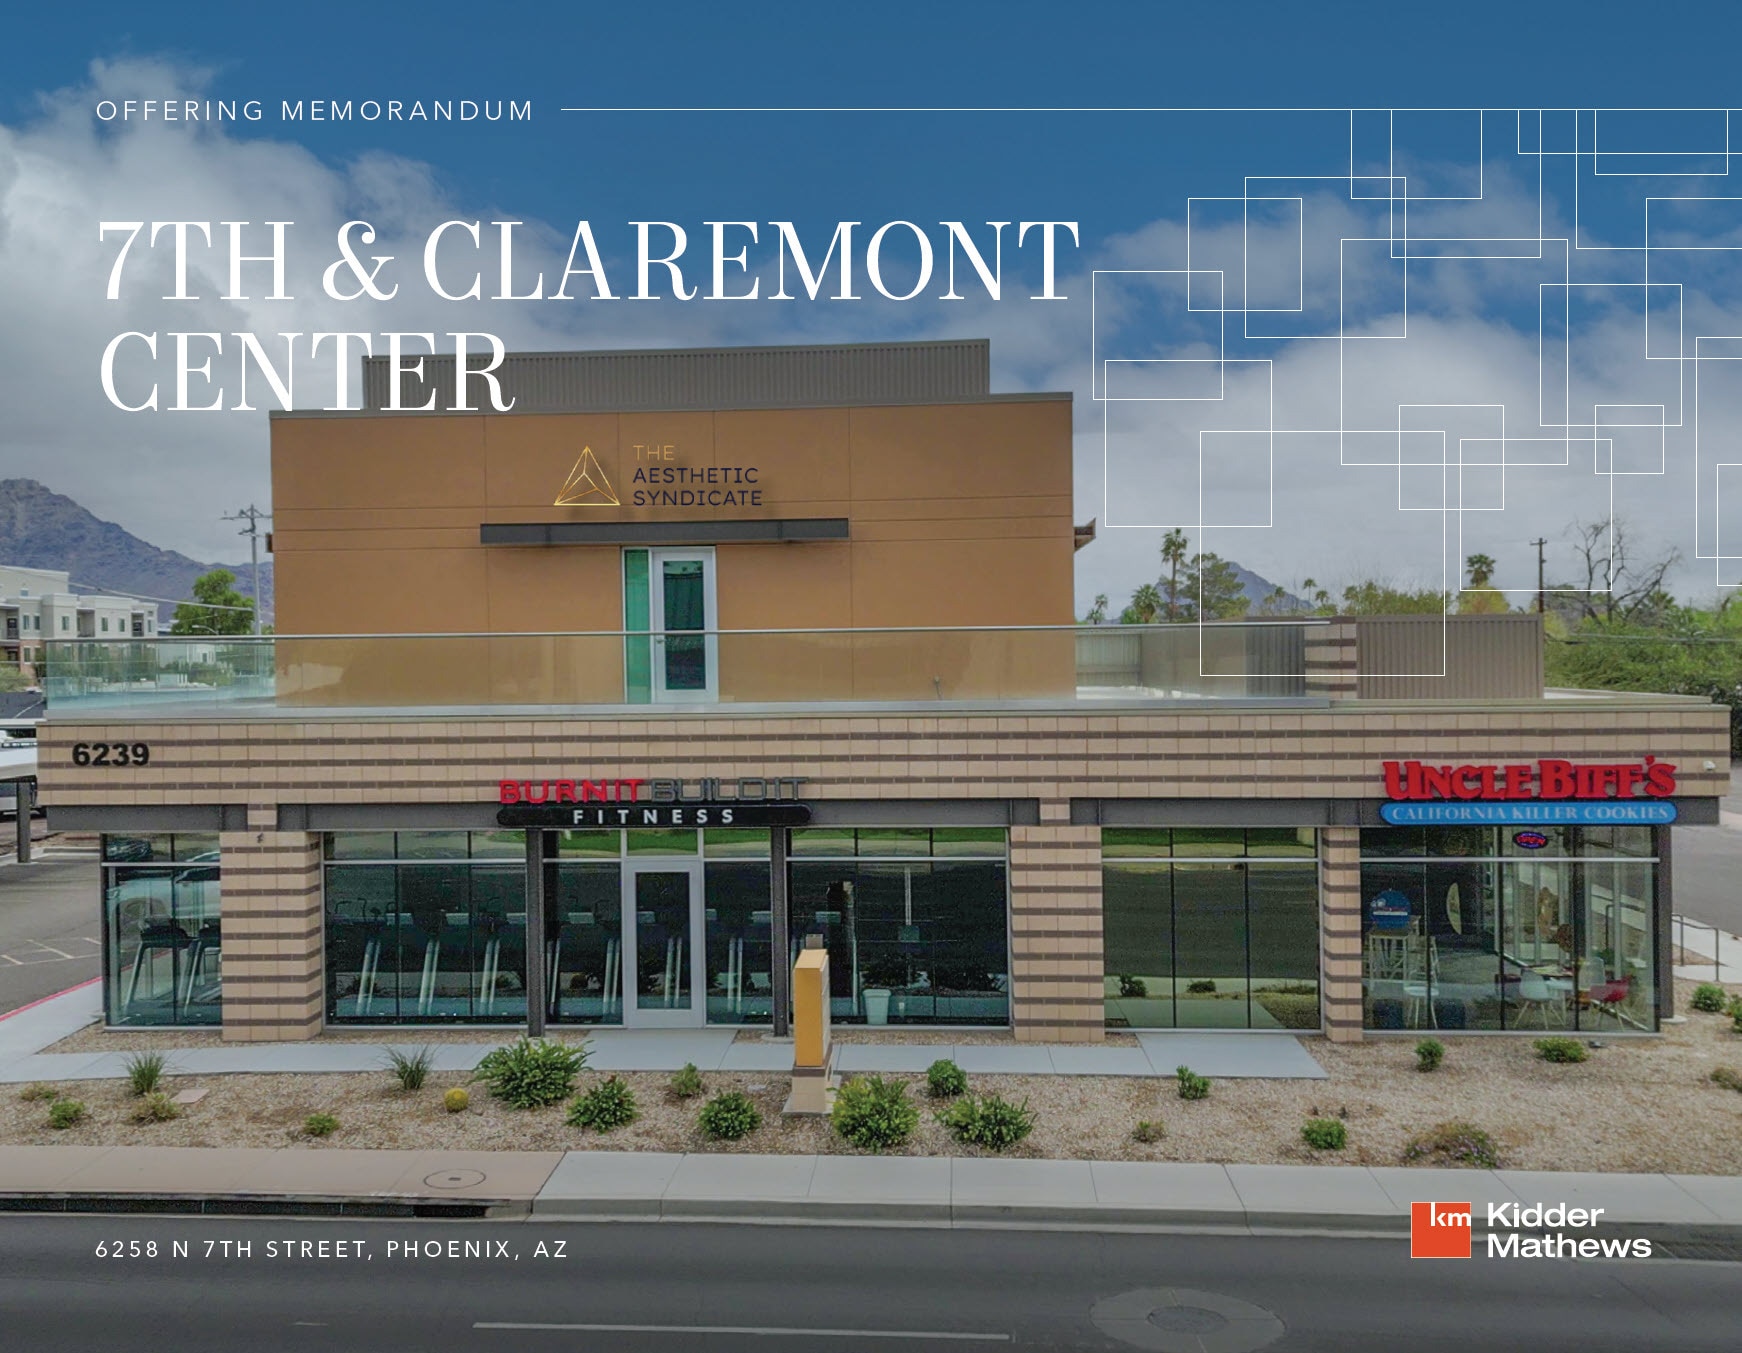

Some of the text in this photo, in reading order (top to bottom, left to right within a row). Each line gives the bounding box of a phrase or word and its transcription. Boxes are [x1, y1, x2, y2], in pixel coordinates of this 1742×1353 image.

[633, 445, 675, 461] THE
[633, 467, 759, 484] AESTHETIC
[633, 490, 763, 506] SYNDICATE
[72, 743, 150, 767] 6239
[1382, 760, 1533, 801] UNCLE
[499, 779, 644, 804] BURNIT
[573, 809, 734, 824] FITNESS
[1391, 806, 1669, 821] CALIFORNIA KILLER COOKIES
